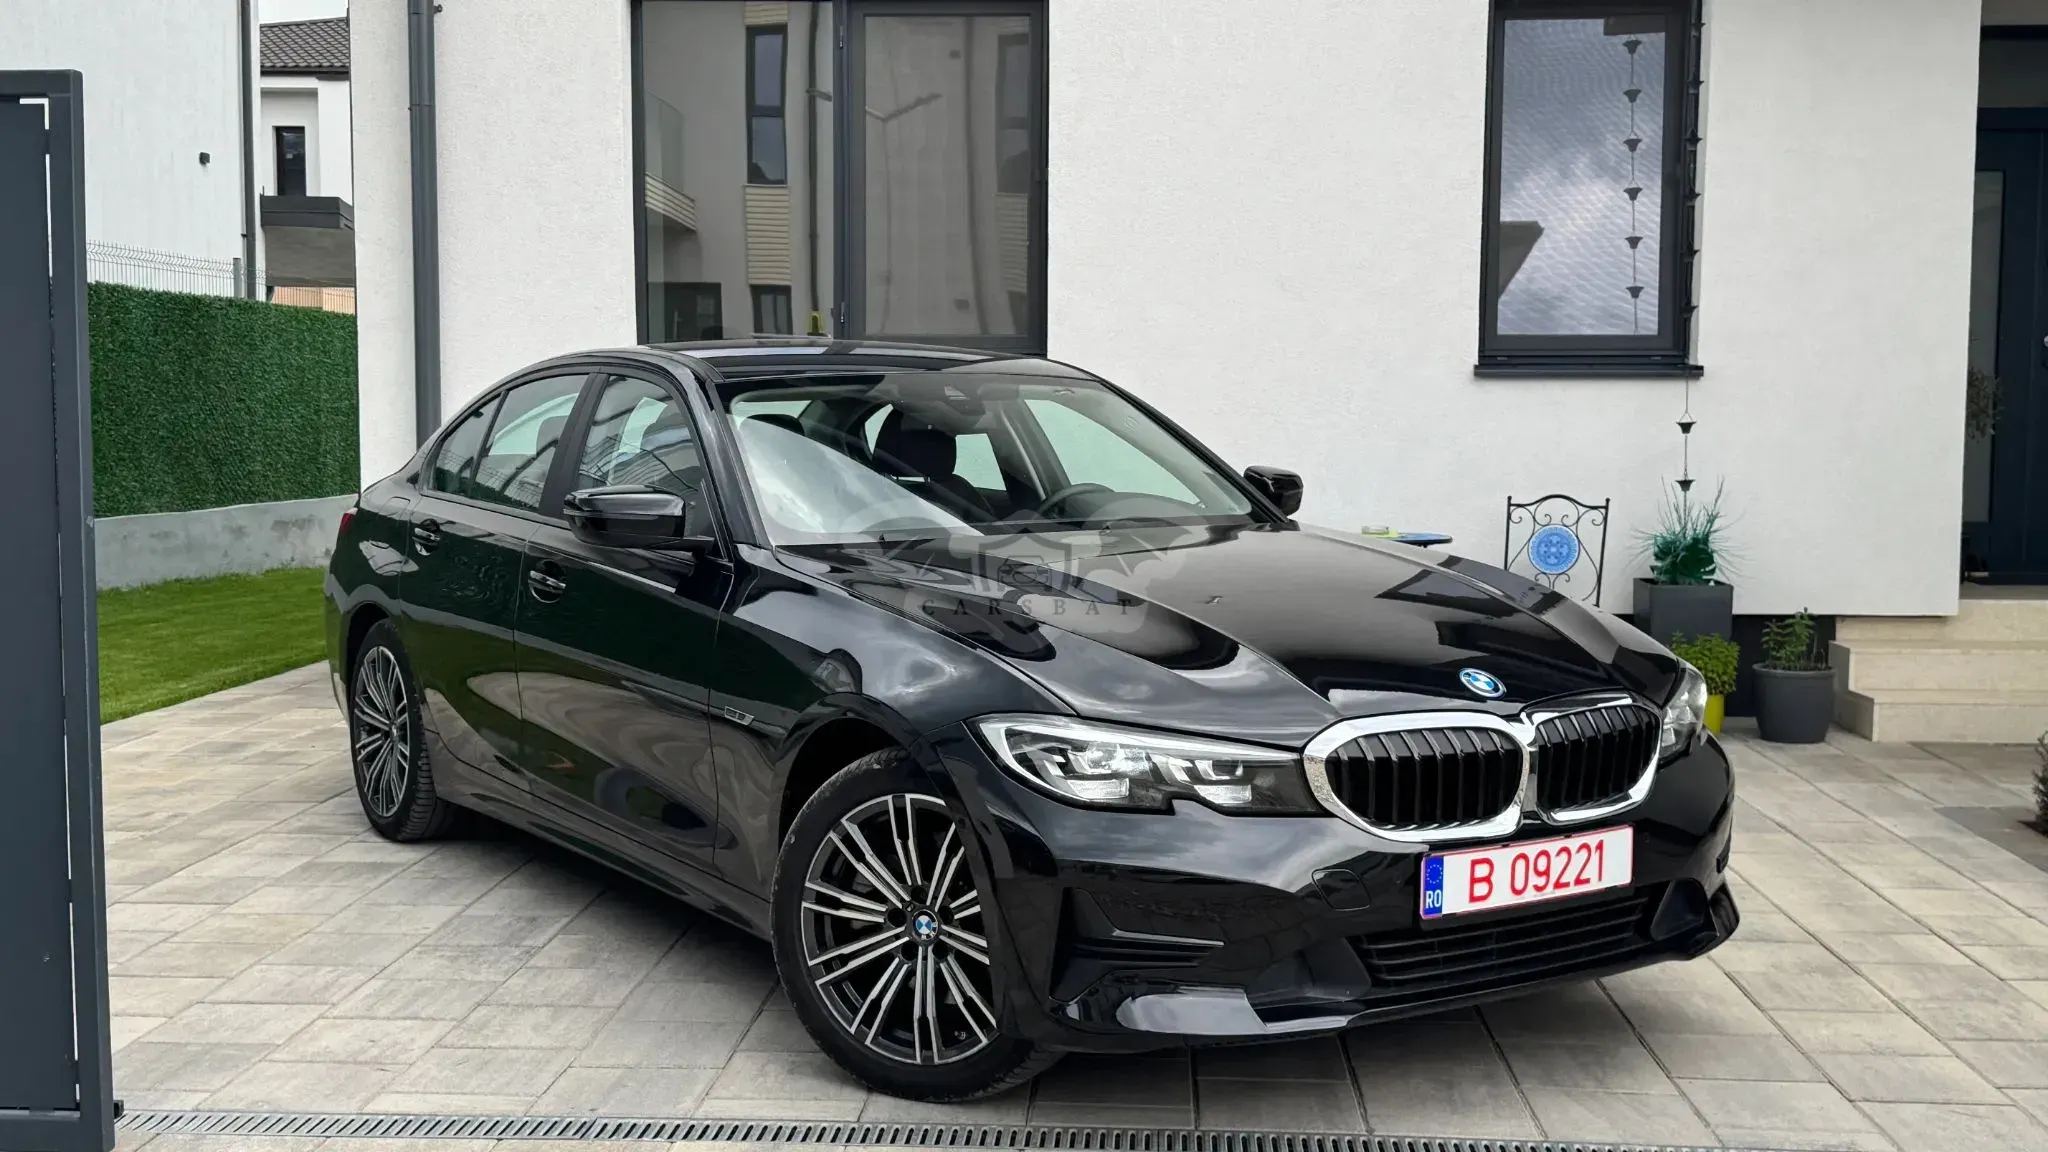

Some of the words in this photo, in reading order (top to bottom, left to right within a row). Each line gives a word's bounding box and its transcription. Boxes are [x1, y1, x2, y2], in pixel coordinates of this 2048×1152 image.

[1468, 857, 1495, 904] B
[1510, 839, 1604, 896] 09221
[1425, 889, 1442, 909] RO
